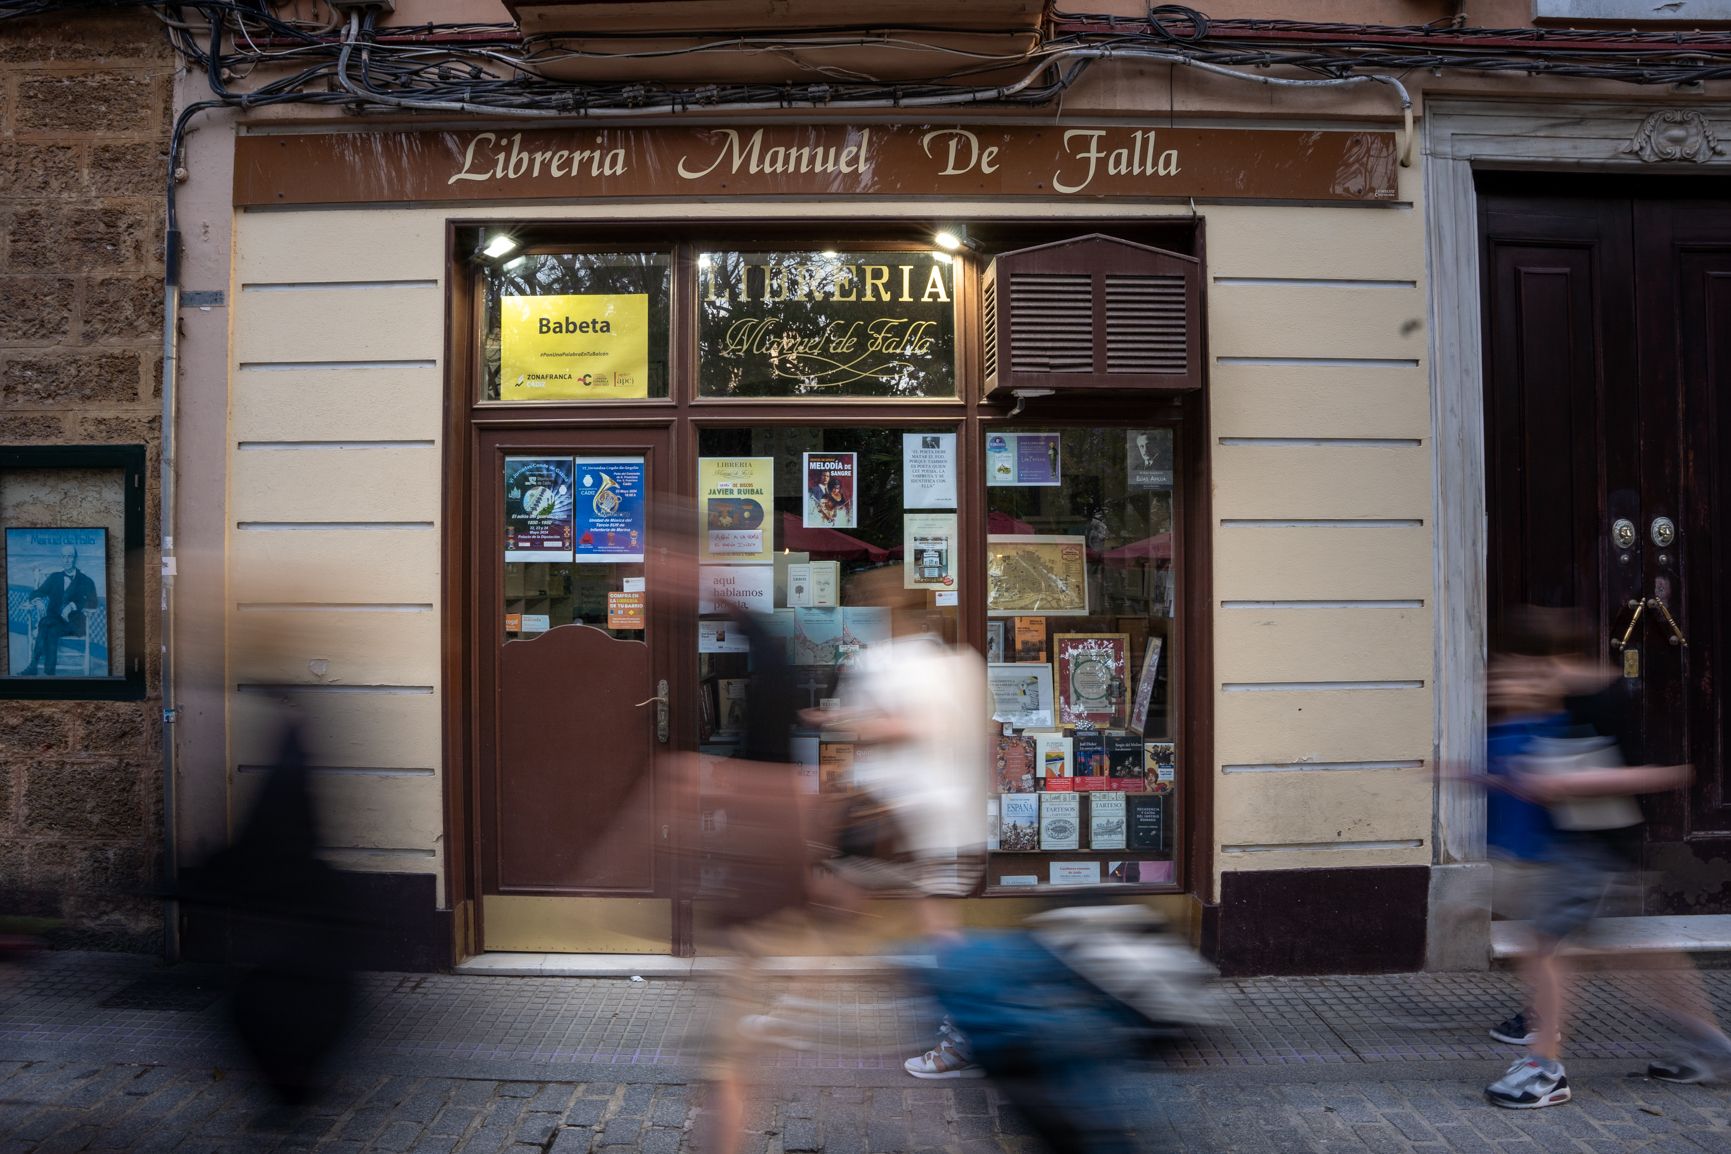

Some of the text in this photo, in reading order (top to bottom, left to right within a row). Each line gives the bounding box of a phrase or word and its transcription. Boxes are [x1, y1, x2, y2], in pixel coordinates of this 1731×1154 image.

[447, 128, 1182, 194] Libreria Manuel De Falla
[538, 316, 611, 335] Babeta
[830, 321, 863, 354] de
[868, 318, 938, 355] Falla
[809, 460, 843, 470] MELODÍA
[713, 588, 763, 597] hablamos
[1007, 801, 1033, 813] ESPAÑA
